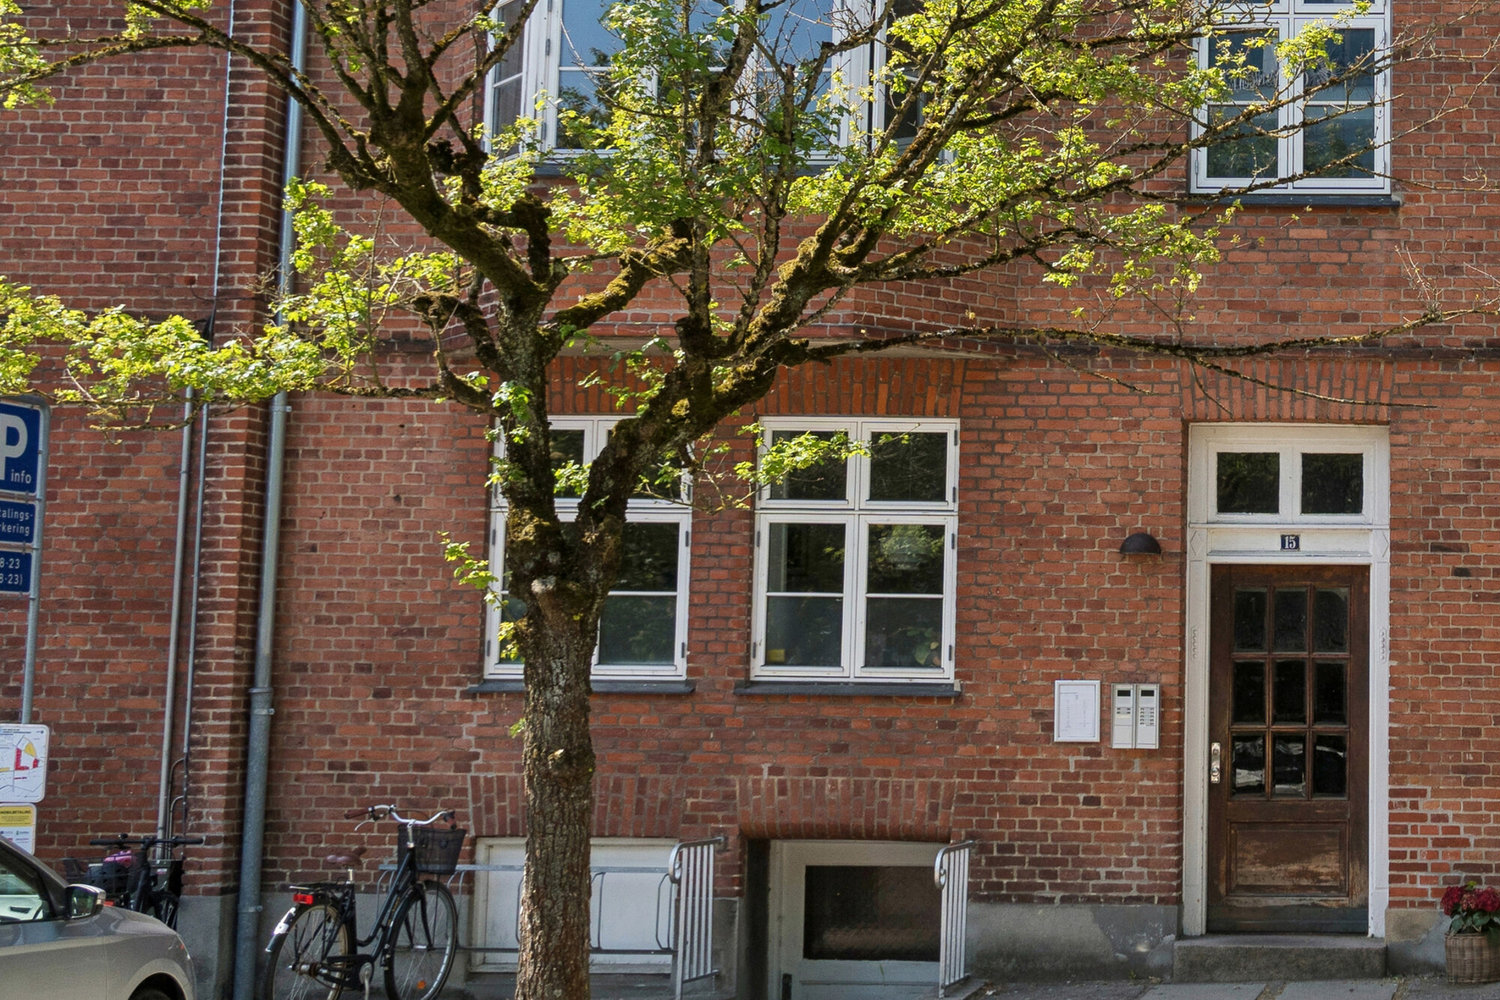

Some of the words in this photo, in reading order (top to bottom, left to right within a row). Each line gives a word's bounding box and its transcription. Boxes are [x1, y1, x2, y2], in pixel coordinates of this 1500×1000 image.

[0, 413, 28, 480] P
[11, 469, 32, 484] info
[1285, 536, 1296, 549] 15
